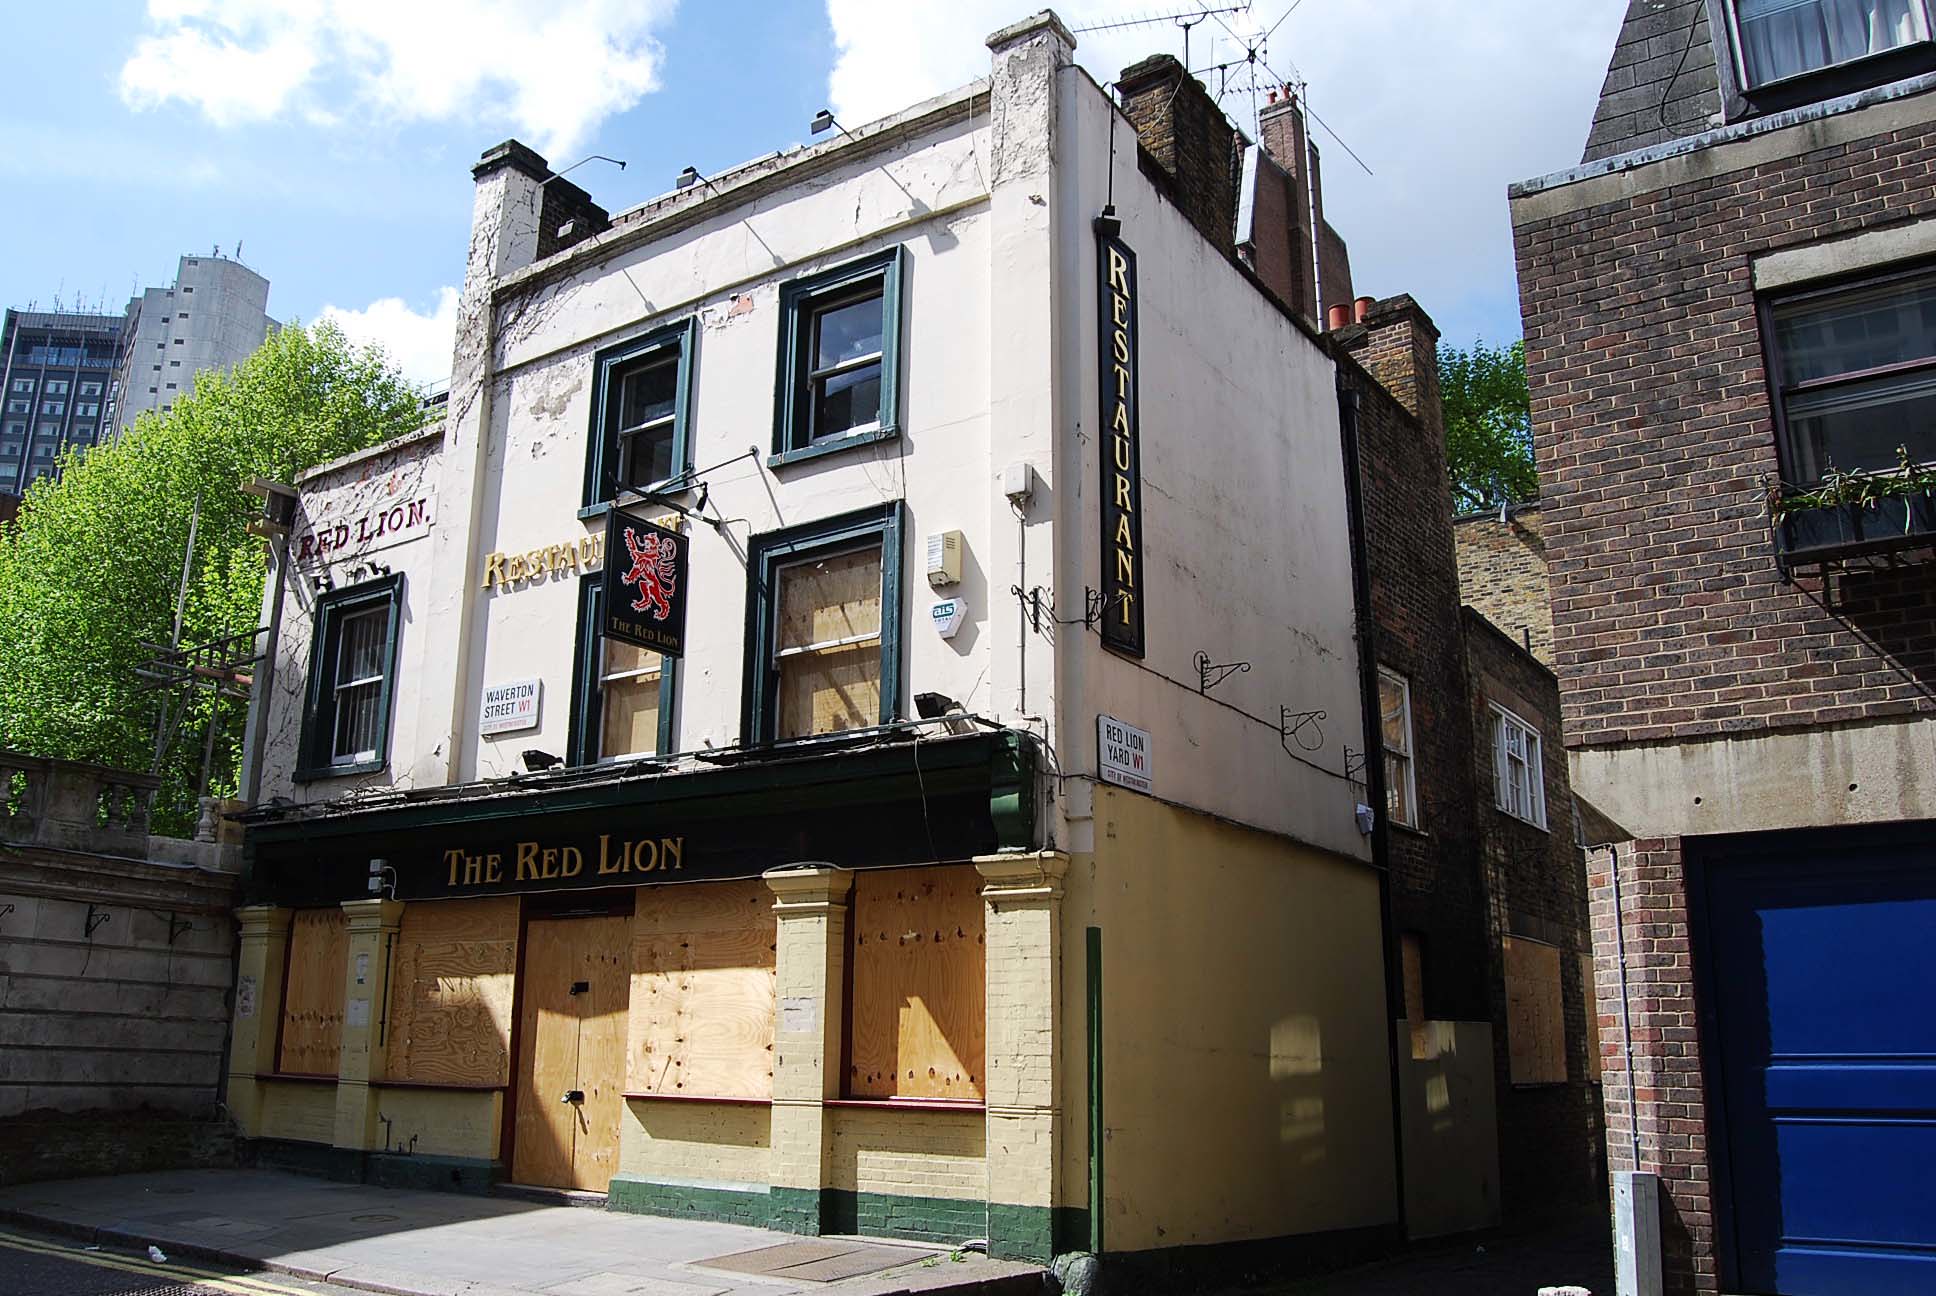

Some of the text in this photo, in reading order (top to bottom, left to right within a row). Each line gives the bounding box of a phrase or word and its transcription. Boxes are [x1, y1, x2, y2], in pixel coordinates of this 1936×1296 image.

[1108, 246, 1135, 625] RESTAURANT
[298, 524, 350, 560] RED
[611, 616, 679, 648] THE RED LION
[486, 684, 534, 703] WAVERTON
[484, 699, 530, 719] STREET W1
[1106, 724, 1144, 752] RED LION
[1107, 744, 1144, 771] YARD W1
[443, 834, 684, 886] THE RED LION
